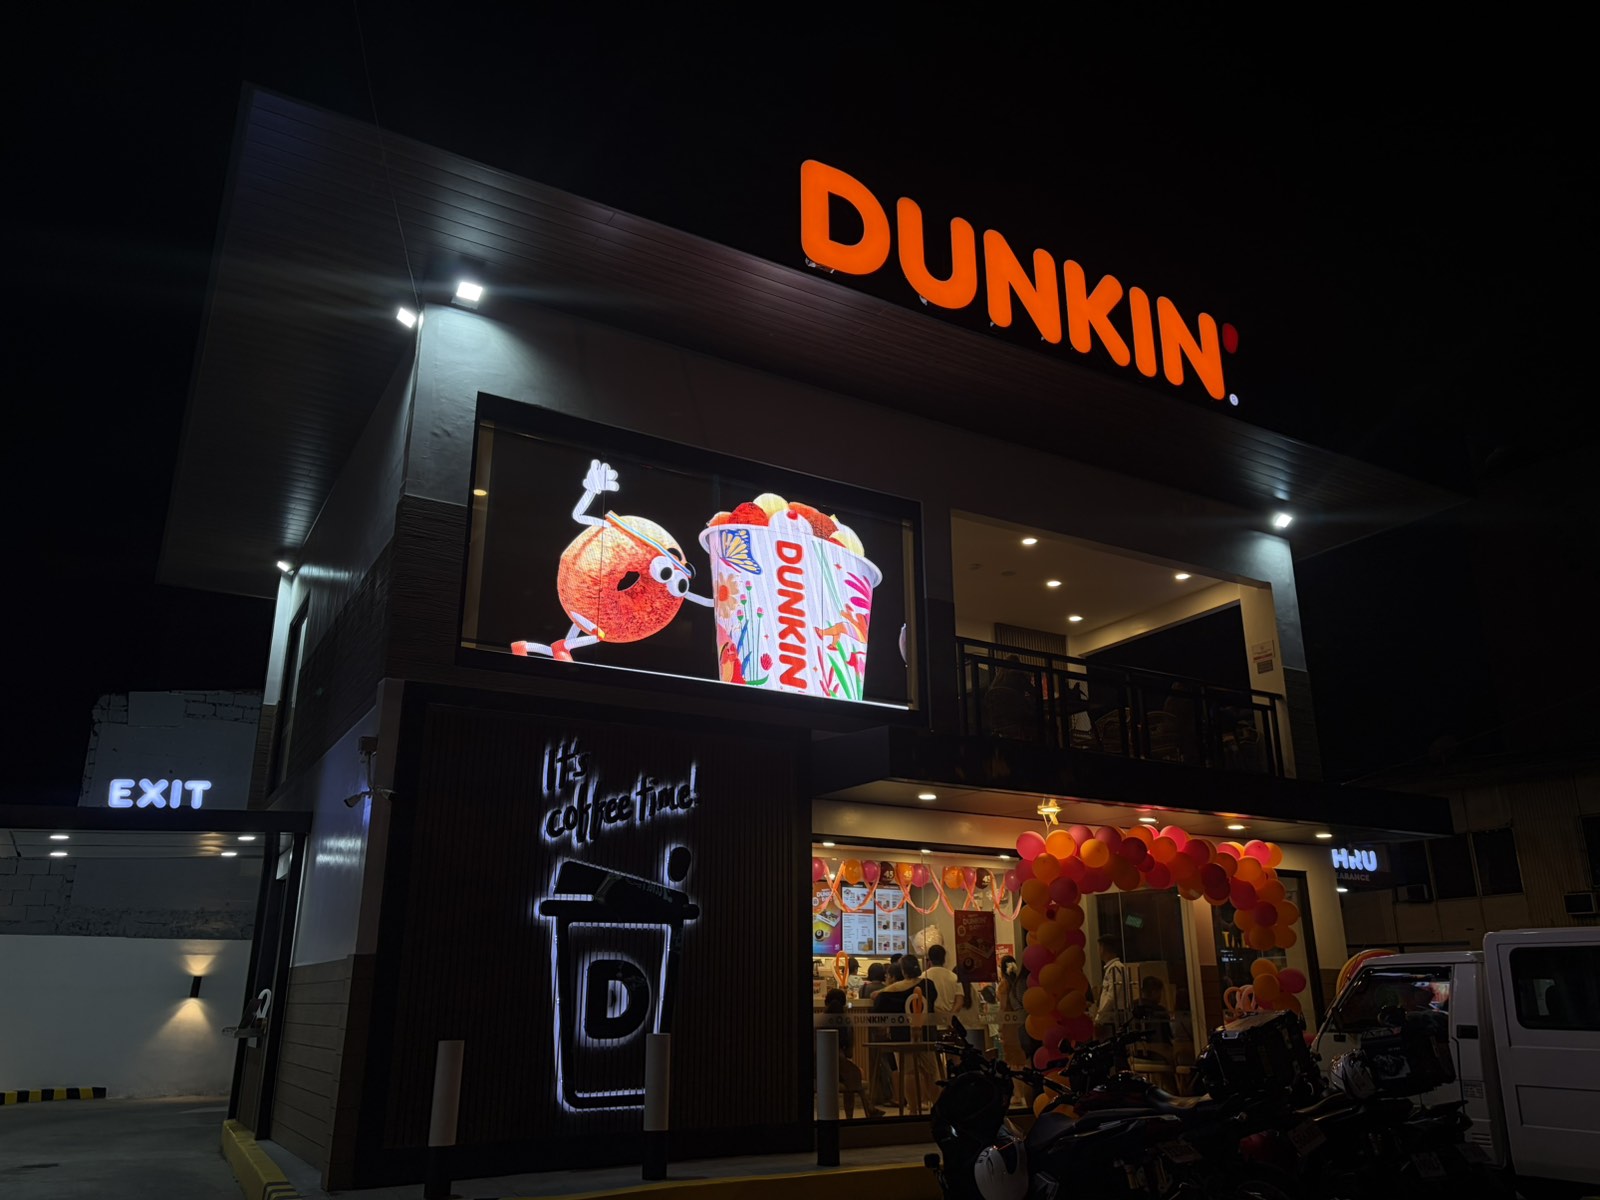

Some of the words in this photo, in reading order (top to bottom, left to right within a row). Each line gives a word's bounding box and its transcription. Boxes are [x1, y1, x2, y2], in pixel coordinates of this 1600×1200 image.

[801, 159, 1239, 400] DUNKIN'
[544, 739, 590, 791] It's
[108, 778, 212, 809] EXIT
[544, 778, 633, 844] coffee
[884, 870, 894, 879] 45
[585, 960, 650, 1039] D
[853, 1015, 889, 1025] DUNKIN'
